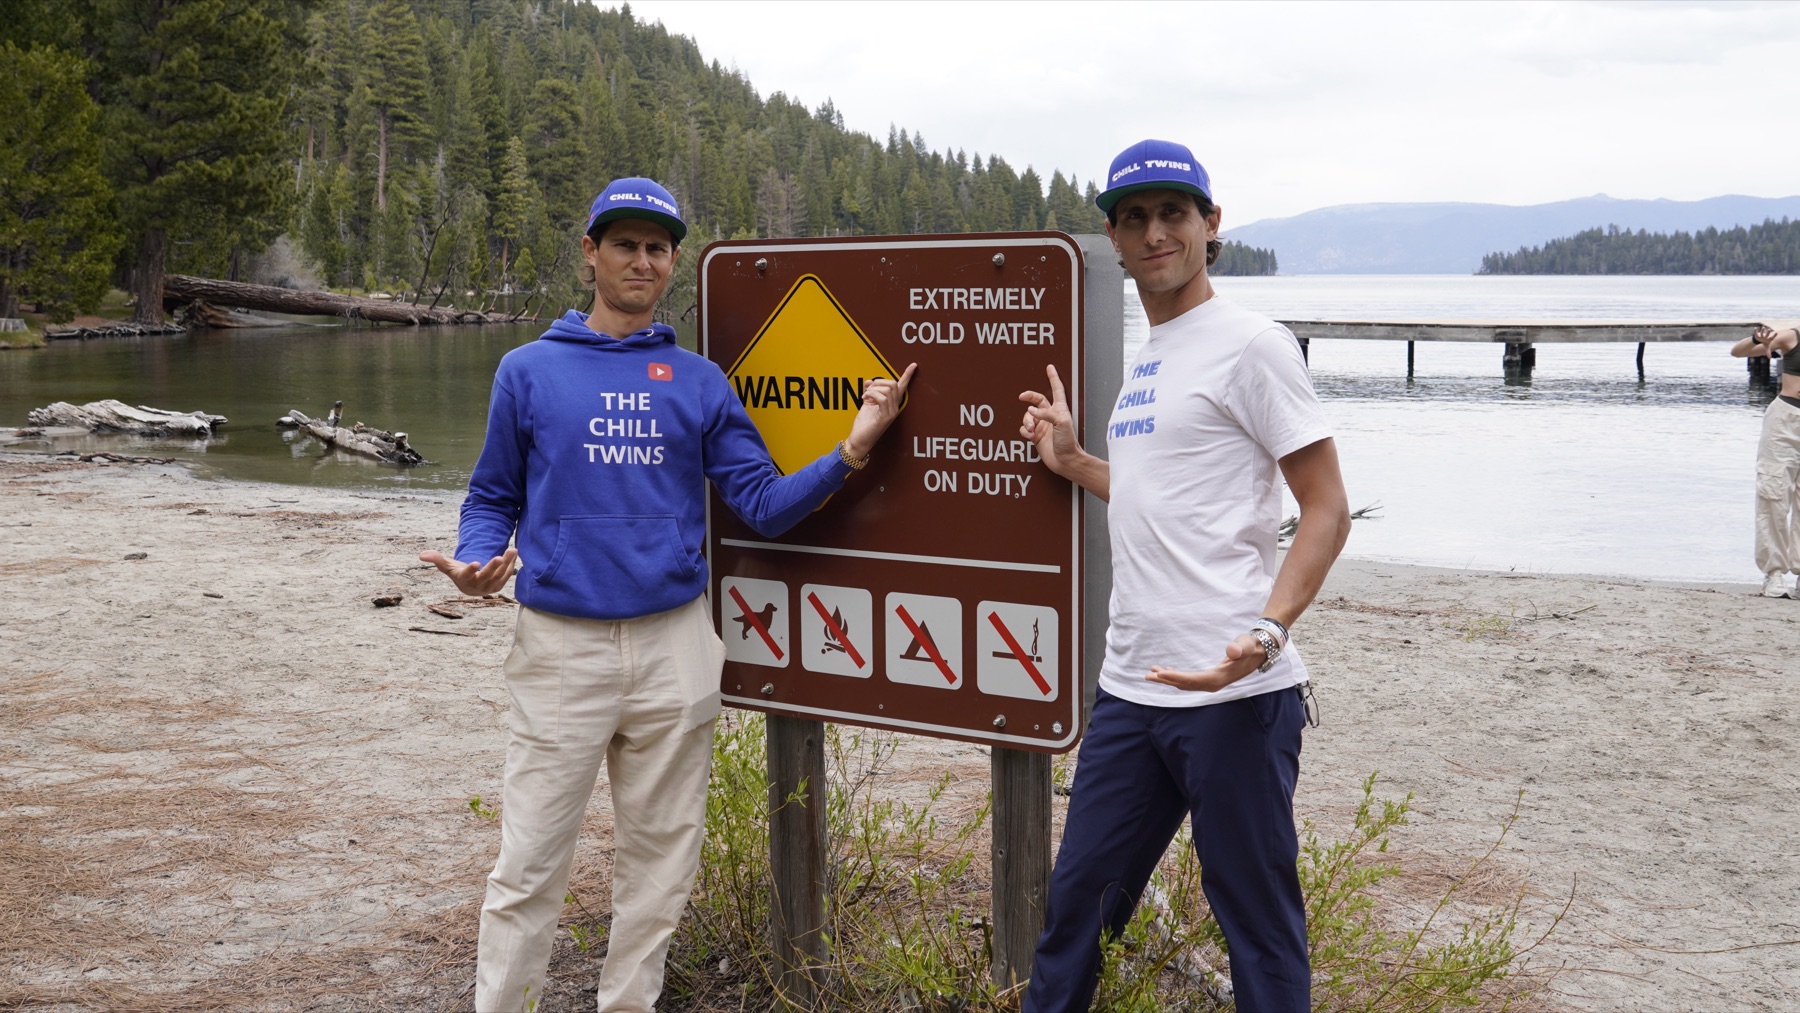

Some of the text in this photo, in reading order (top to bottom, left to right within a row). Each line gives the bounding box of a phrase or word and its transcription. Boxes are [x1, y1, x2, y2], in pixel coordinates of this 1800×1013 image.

[1112, 160, 1191, 181] CHILL TWINS
[609, 193, 677, 214] CHILL TWINS
[909, 287, 1046, 310] EXTREMELY
[901, 322, 1055, 345] COLD WATER
[1131, 360, 1162, 380] THE
[600, 392, 651, 411] THE
[734, 375, 885, 411] WARNIN
[1117, 388, 1156, 410] CHILL
[960, 404, 994, 427] NO
[589, 417, 663, 438] CHILL
[1108, 415, 1156, 440] TWINS
[583, 443, 665, 465] TWINS
[913, 436, 1042, 463] LIFEGUARD
[923, 469, 1032, 497] ON DUTY
